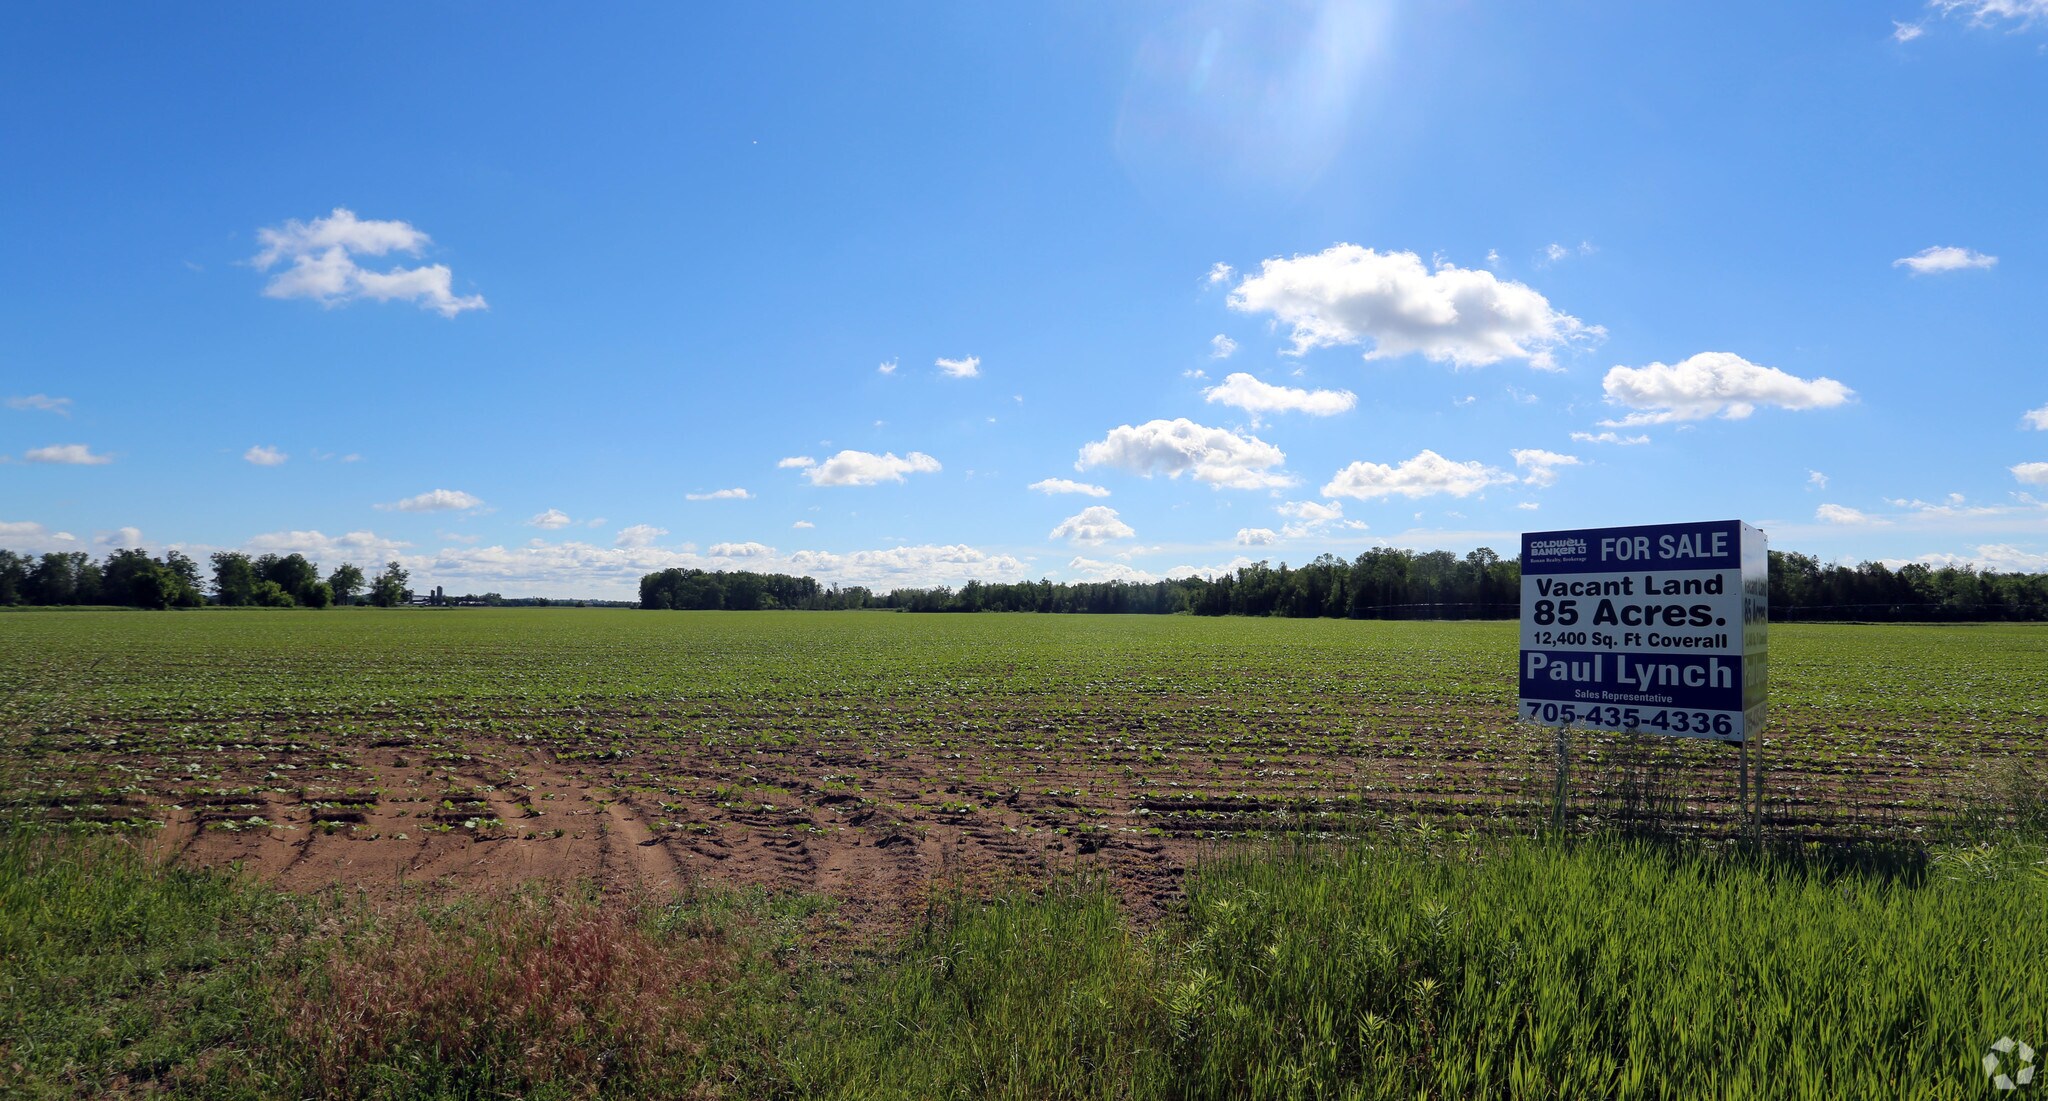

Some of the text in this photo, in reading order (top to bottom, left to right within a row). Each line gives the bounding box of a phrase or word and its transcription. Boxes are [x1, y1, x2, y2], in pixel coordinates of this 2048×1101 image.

[1530, 538, 1587, 549] COLDWELL
[1531, 547, 1576, 556] BANKER
[1601, 532, 1728, 561] FOR SALE
[1536, 576, 1633, 597] Vacant
[1645, 574, 1724, 596] Land
[1533, 599, 1726, 627] 85 Acres.
[1534, 632, 1727, 649] 12,400 Sq. Ft Coverall
[1527, 652, 1602, 682] Paul
[1617, 655, 1732, 692] Lynch
[1575, 689, 1673, 703] Sales Representative
[1526, 702, 1733, 735] 705-435-4336
